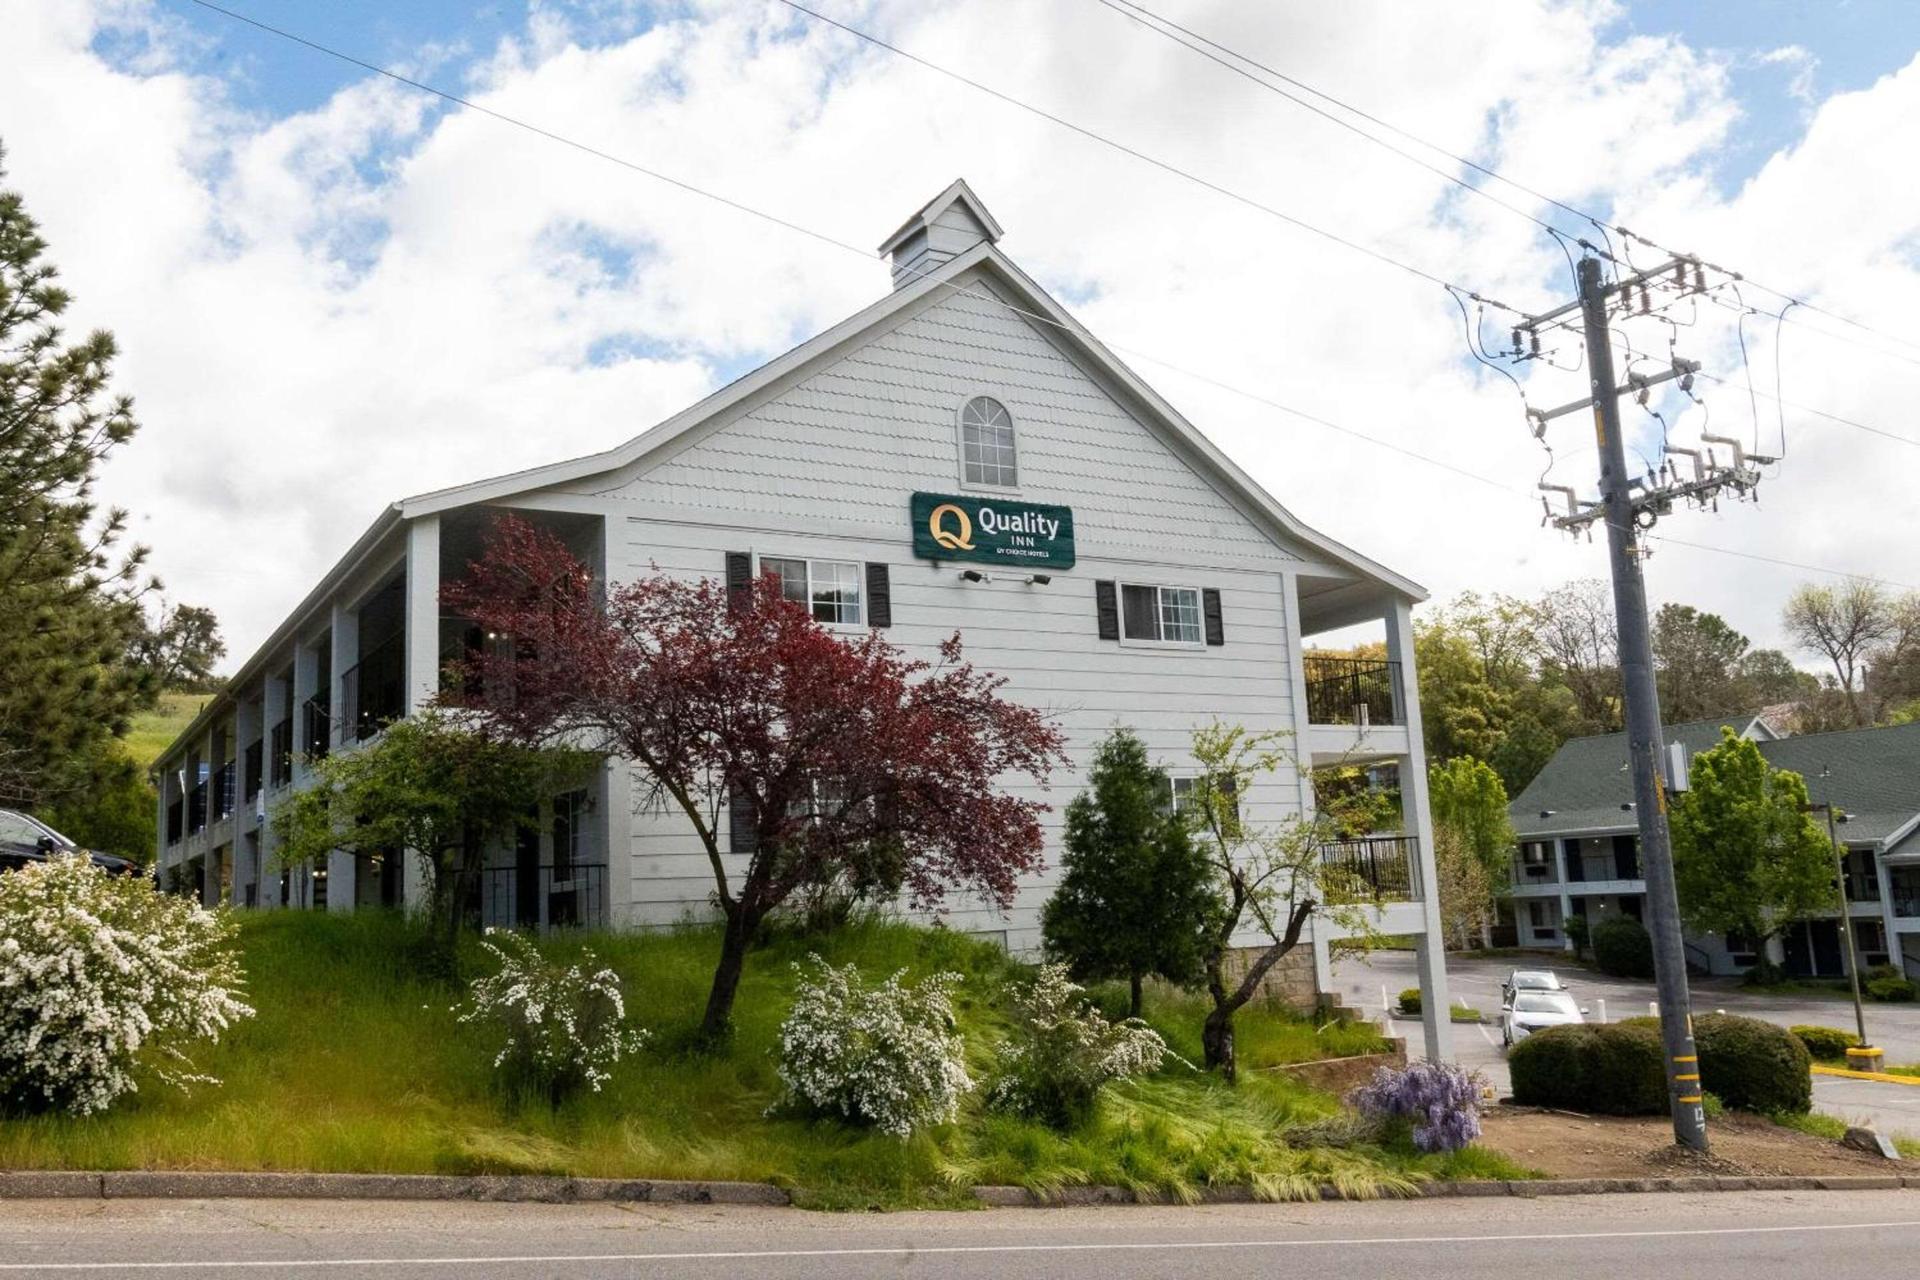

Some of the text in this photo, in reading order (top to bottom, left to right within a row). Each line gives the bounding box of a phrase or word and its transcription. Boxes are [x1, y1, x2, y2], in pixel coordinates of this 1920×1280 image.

[930, 504, 976, 550] Q
[979, 507, 1059, 540] Quality
[1011, 536, 1035, 547] INN
[1005, 548, 1027, 556] CHOICE
[1027, 550, 1049, 558] HOTELS
